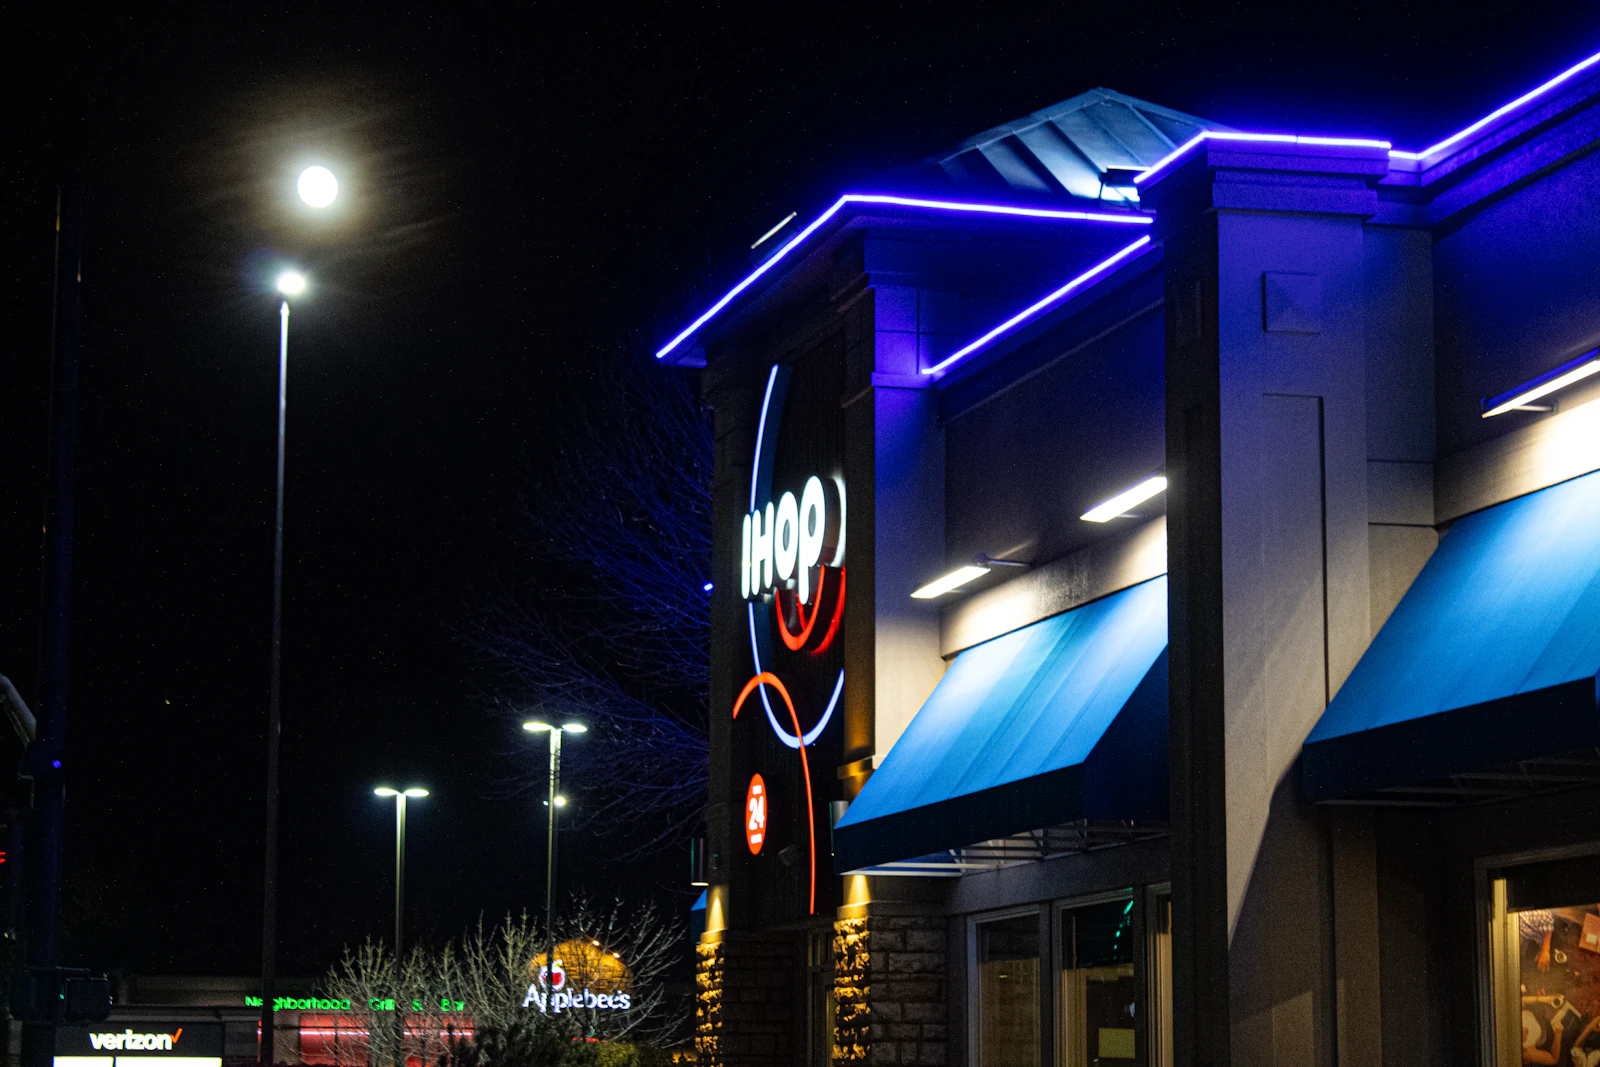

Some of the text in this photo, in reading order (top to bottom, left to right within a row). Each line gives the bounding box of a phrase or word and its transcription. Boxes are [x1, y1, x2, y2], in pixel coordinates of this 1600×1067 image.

[749, 796, 765, 830] 24
[412, 998, 424, 1011] &
[522, 983, 631, 1013] Applebee's
[89, 1028, 173, 1050] verizon
